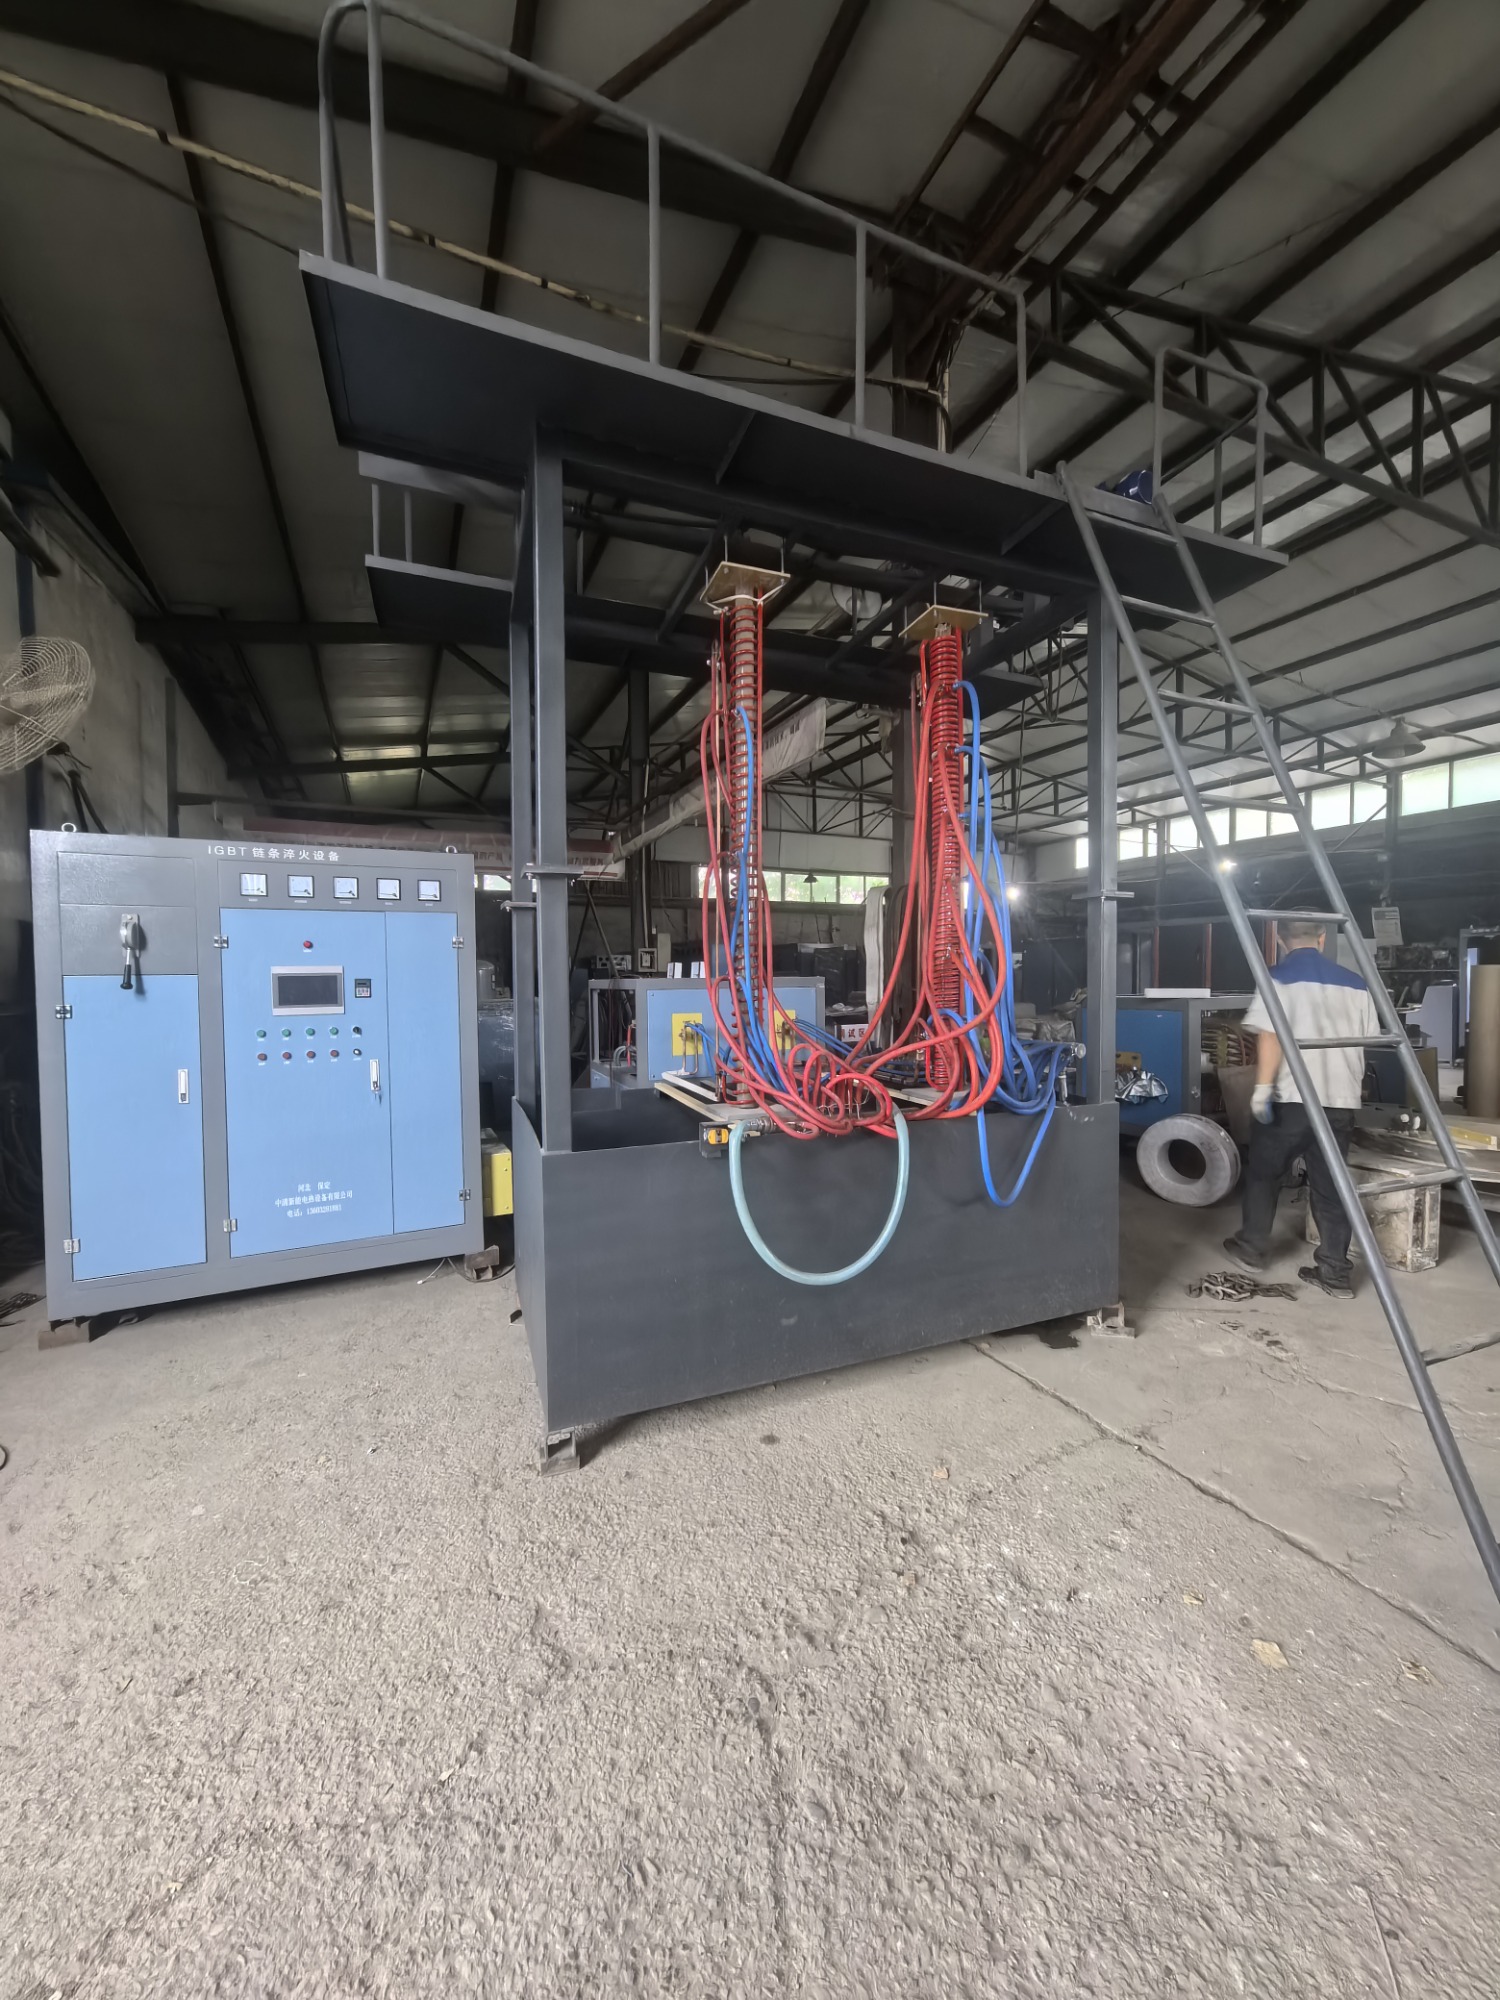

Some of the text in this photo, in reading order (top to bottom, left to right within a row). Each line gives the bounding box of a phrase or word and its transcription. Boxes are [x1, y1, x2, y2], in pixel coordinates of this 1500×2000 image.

[207, 845, 247, 857] IGBT
[252, 847, 340, 862] 链条淬火设备
